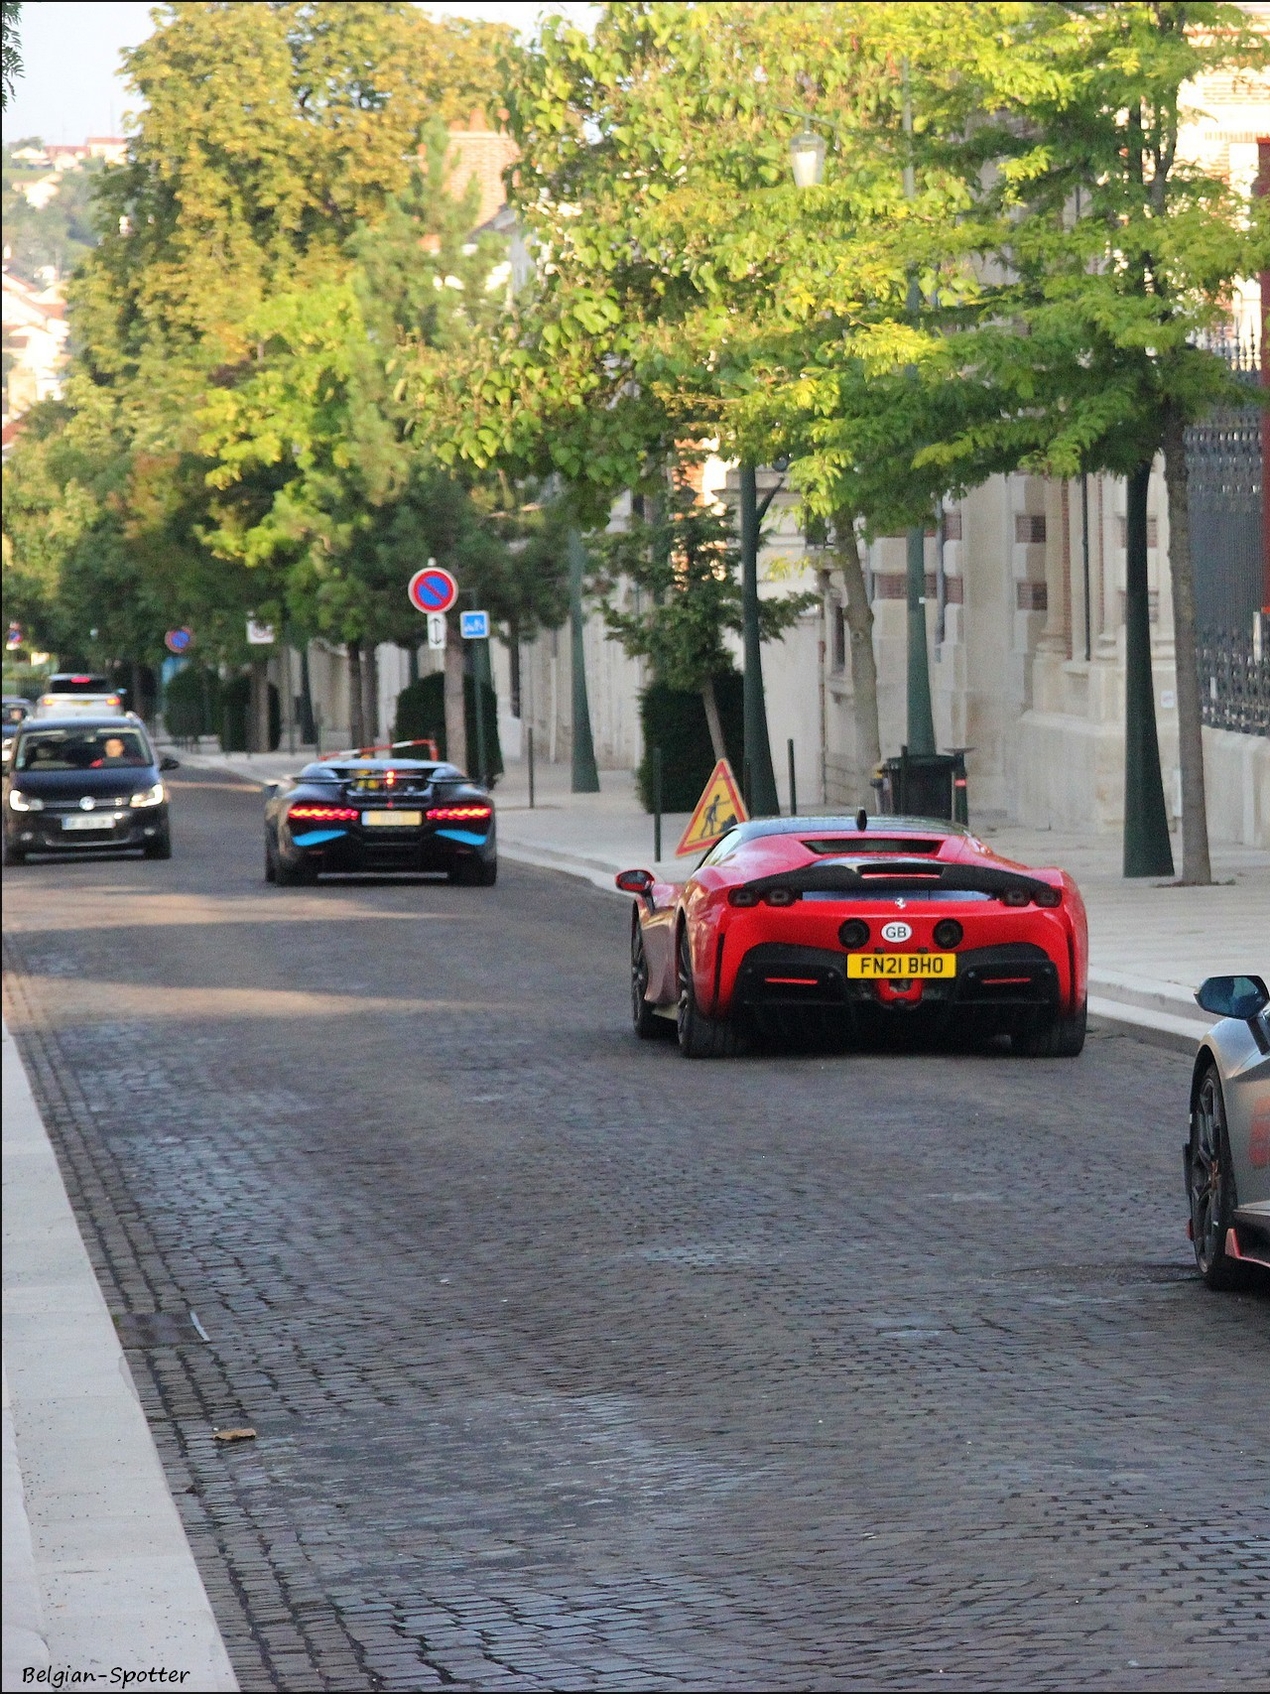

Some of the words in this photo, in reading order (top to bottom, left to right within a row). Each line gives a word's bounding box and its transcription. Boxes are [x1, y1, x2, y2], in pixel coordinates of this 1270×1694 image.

[885, 926, 907, 938] GB
[860, 957, 902, 974] FN21
[908, 957, 944, 974] BHO
